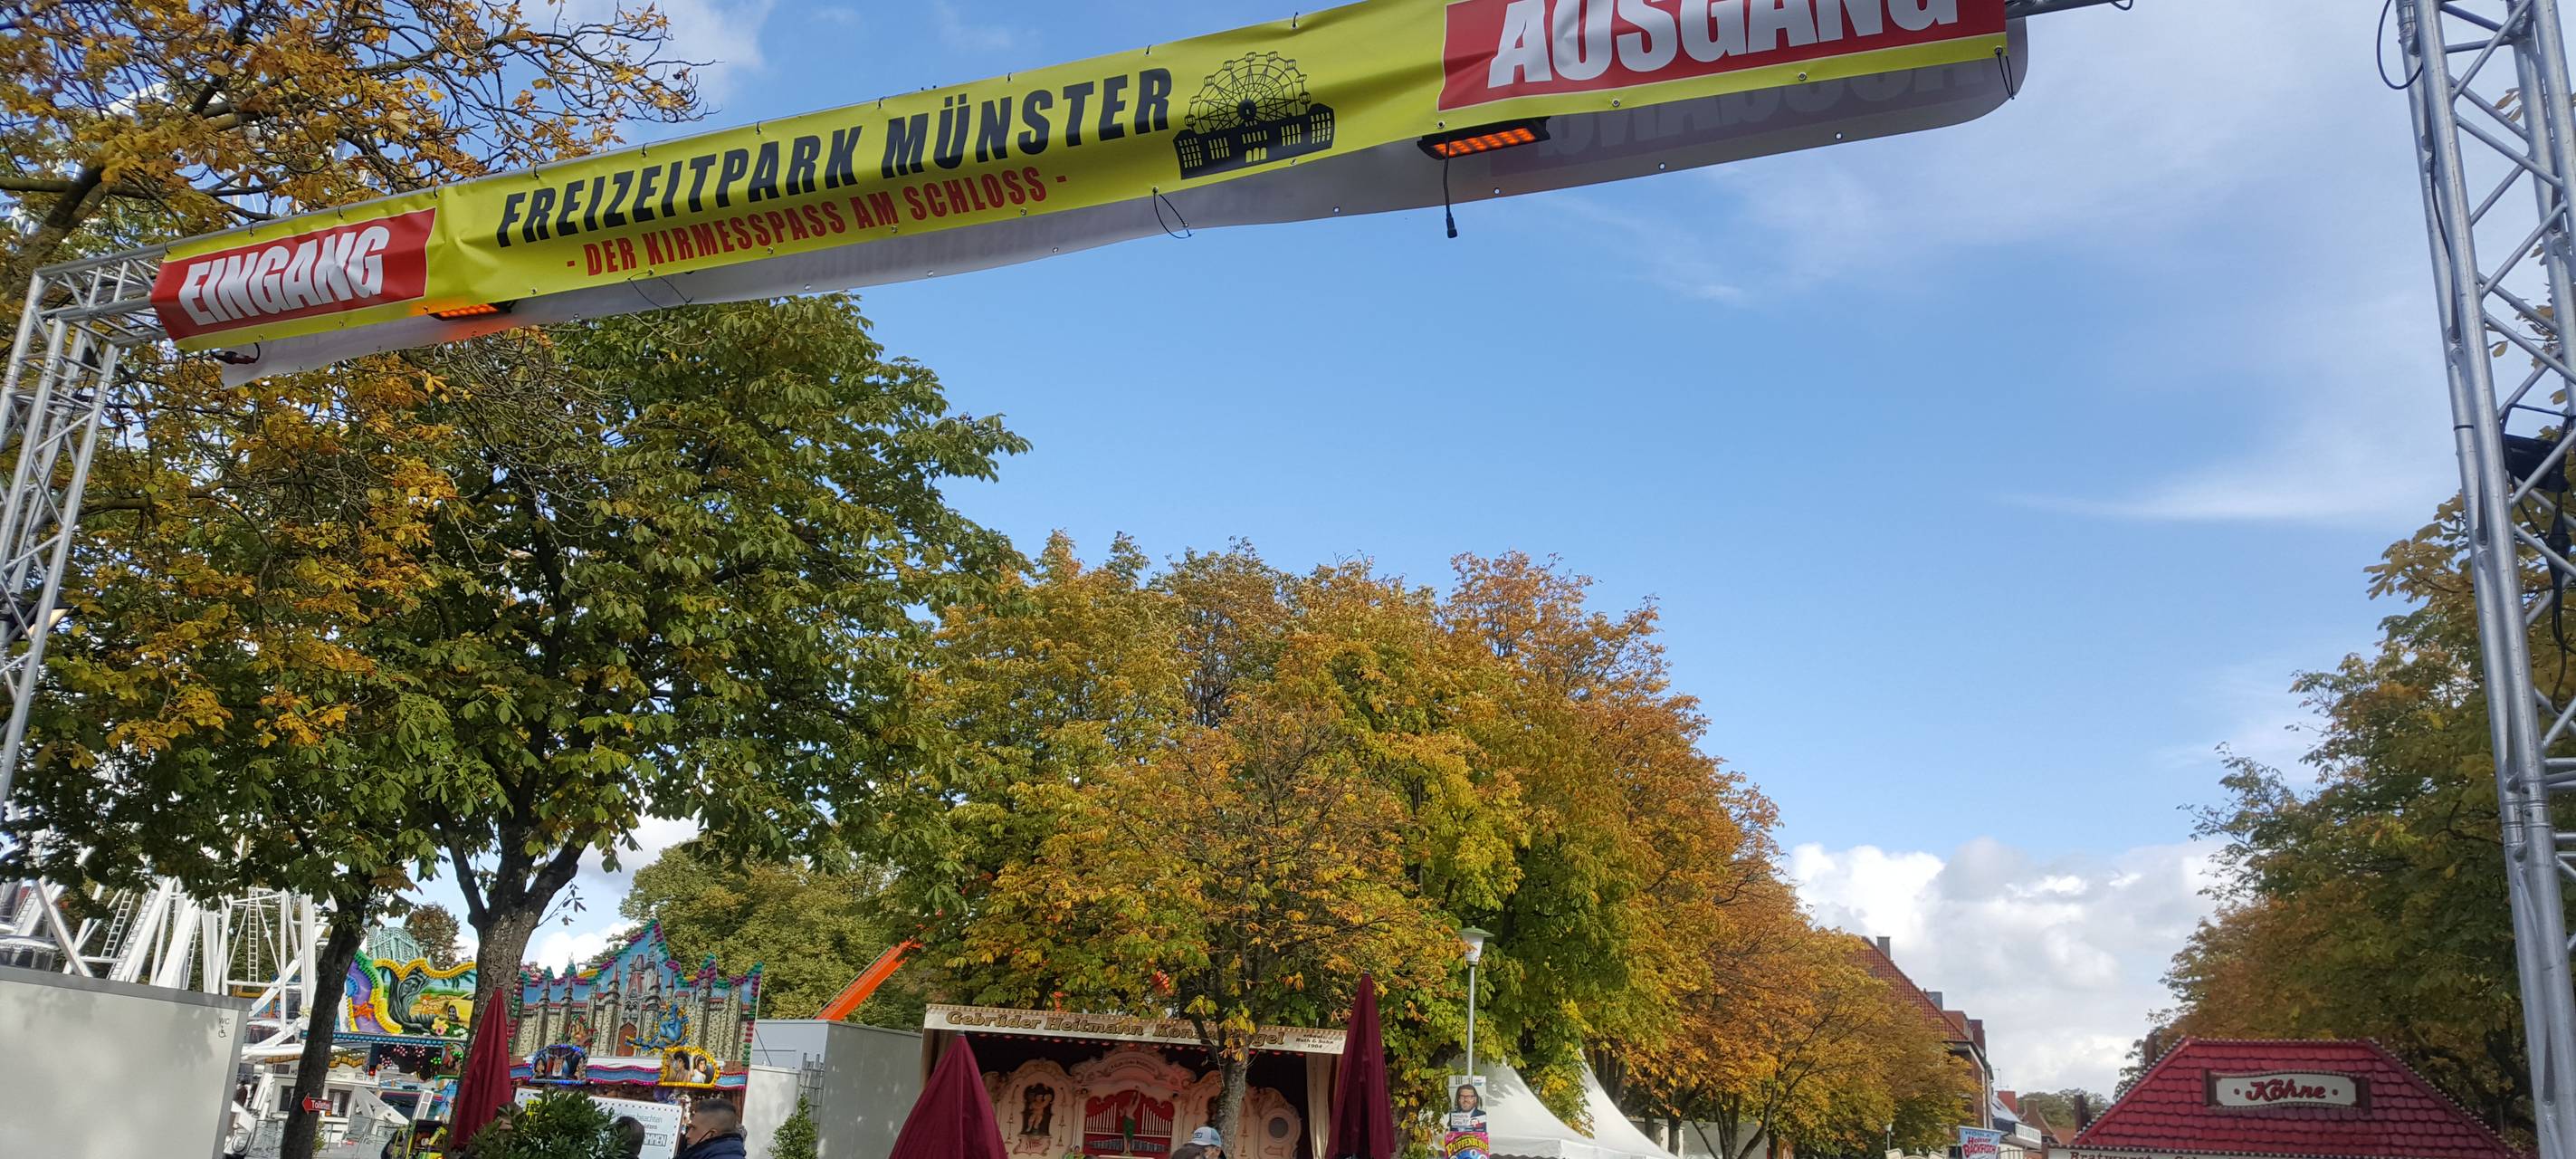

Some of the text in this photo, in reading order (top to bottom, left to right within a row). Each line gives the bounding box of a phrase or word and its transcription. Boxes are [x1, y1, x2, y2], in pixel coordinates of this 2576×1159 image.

[497, 125, 863, 247] FREIZEITPARK
[879, 68, 1172, 178] MÜNSTER
[583, 237, 636, 276] DER
[642, 201, 845, 265] KIRMESSPASS
[849, 191, 899, 229] AM
[902, 167, 1047, 220] SCHLOSS
[178, 225, 390, 326] EINGANG
[218, 1016, 231, 1024] WC
[946, 1011, 1285, 1047] Gebrüder Heitmann Konegel
[2245, 1078, 2326, 1102] Köhne
